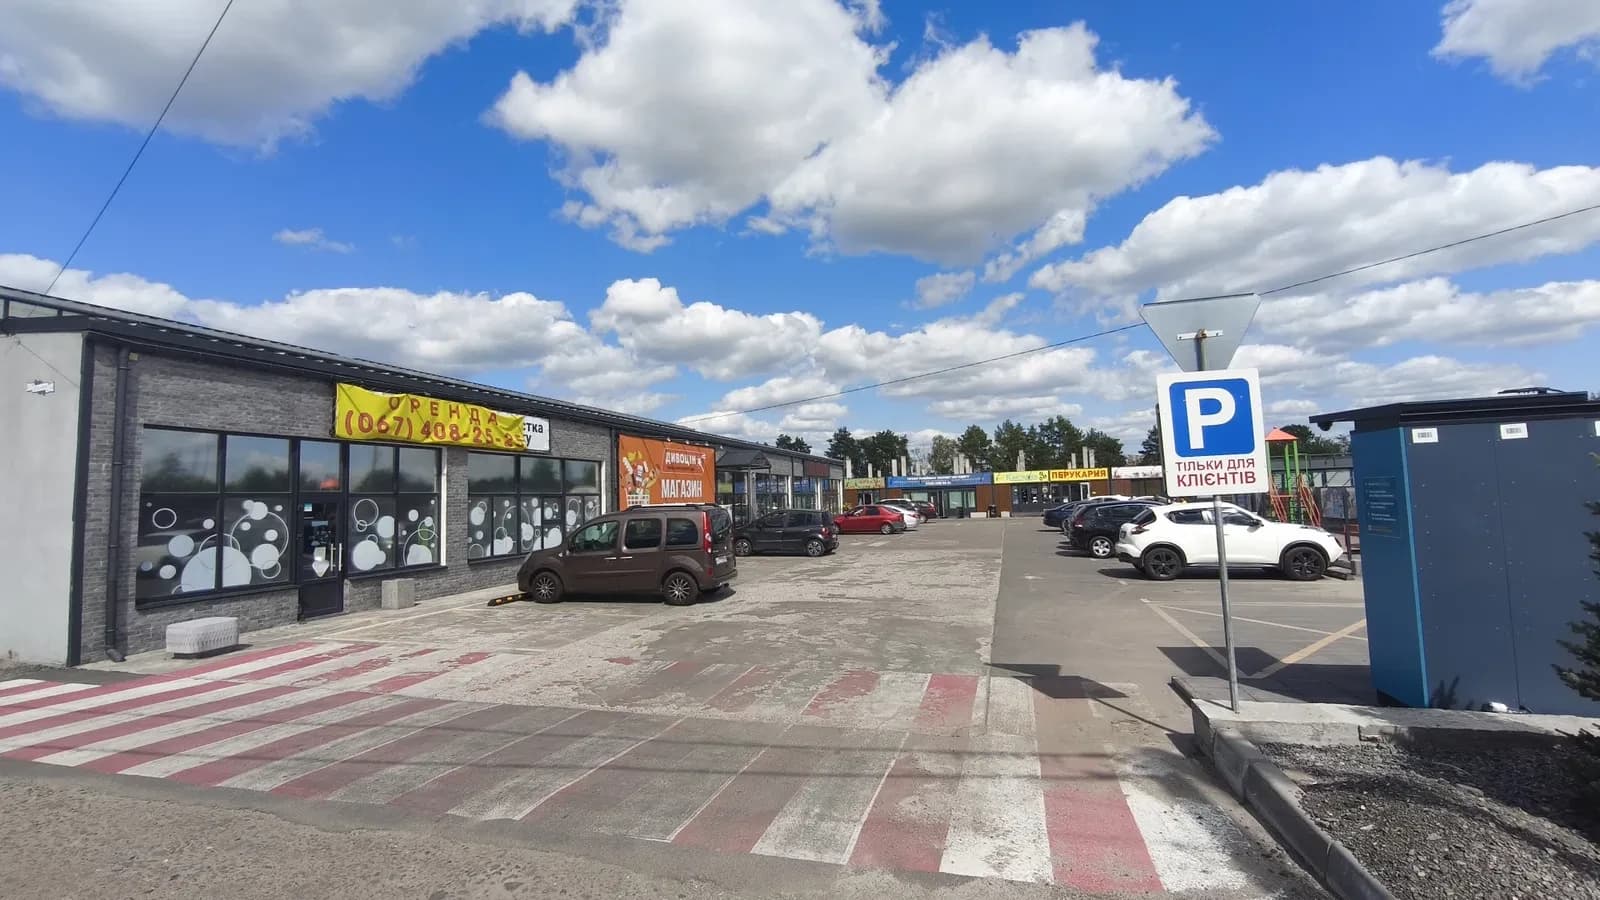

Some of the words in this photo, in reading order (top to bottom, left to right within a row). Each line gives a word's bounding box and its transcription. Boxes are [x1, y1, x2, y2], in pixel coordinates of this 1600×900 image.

[388, 396, 498, 426] ОРЕНДА
[1184, 387, 1236, 450] P
[345, 410, 413, 440] (067)
[1176, 459, 1222, 472] ТІЛЬКИ
[1227, 458, 1255, 471] ДЛЯ
[661, 479, 703, 498] МАГАЗИН
[1176, 470, 1256, 487] КЛІЄНТІВ
